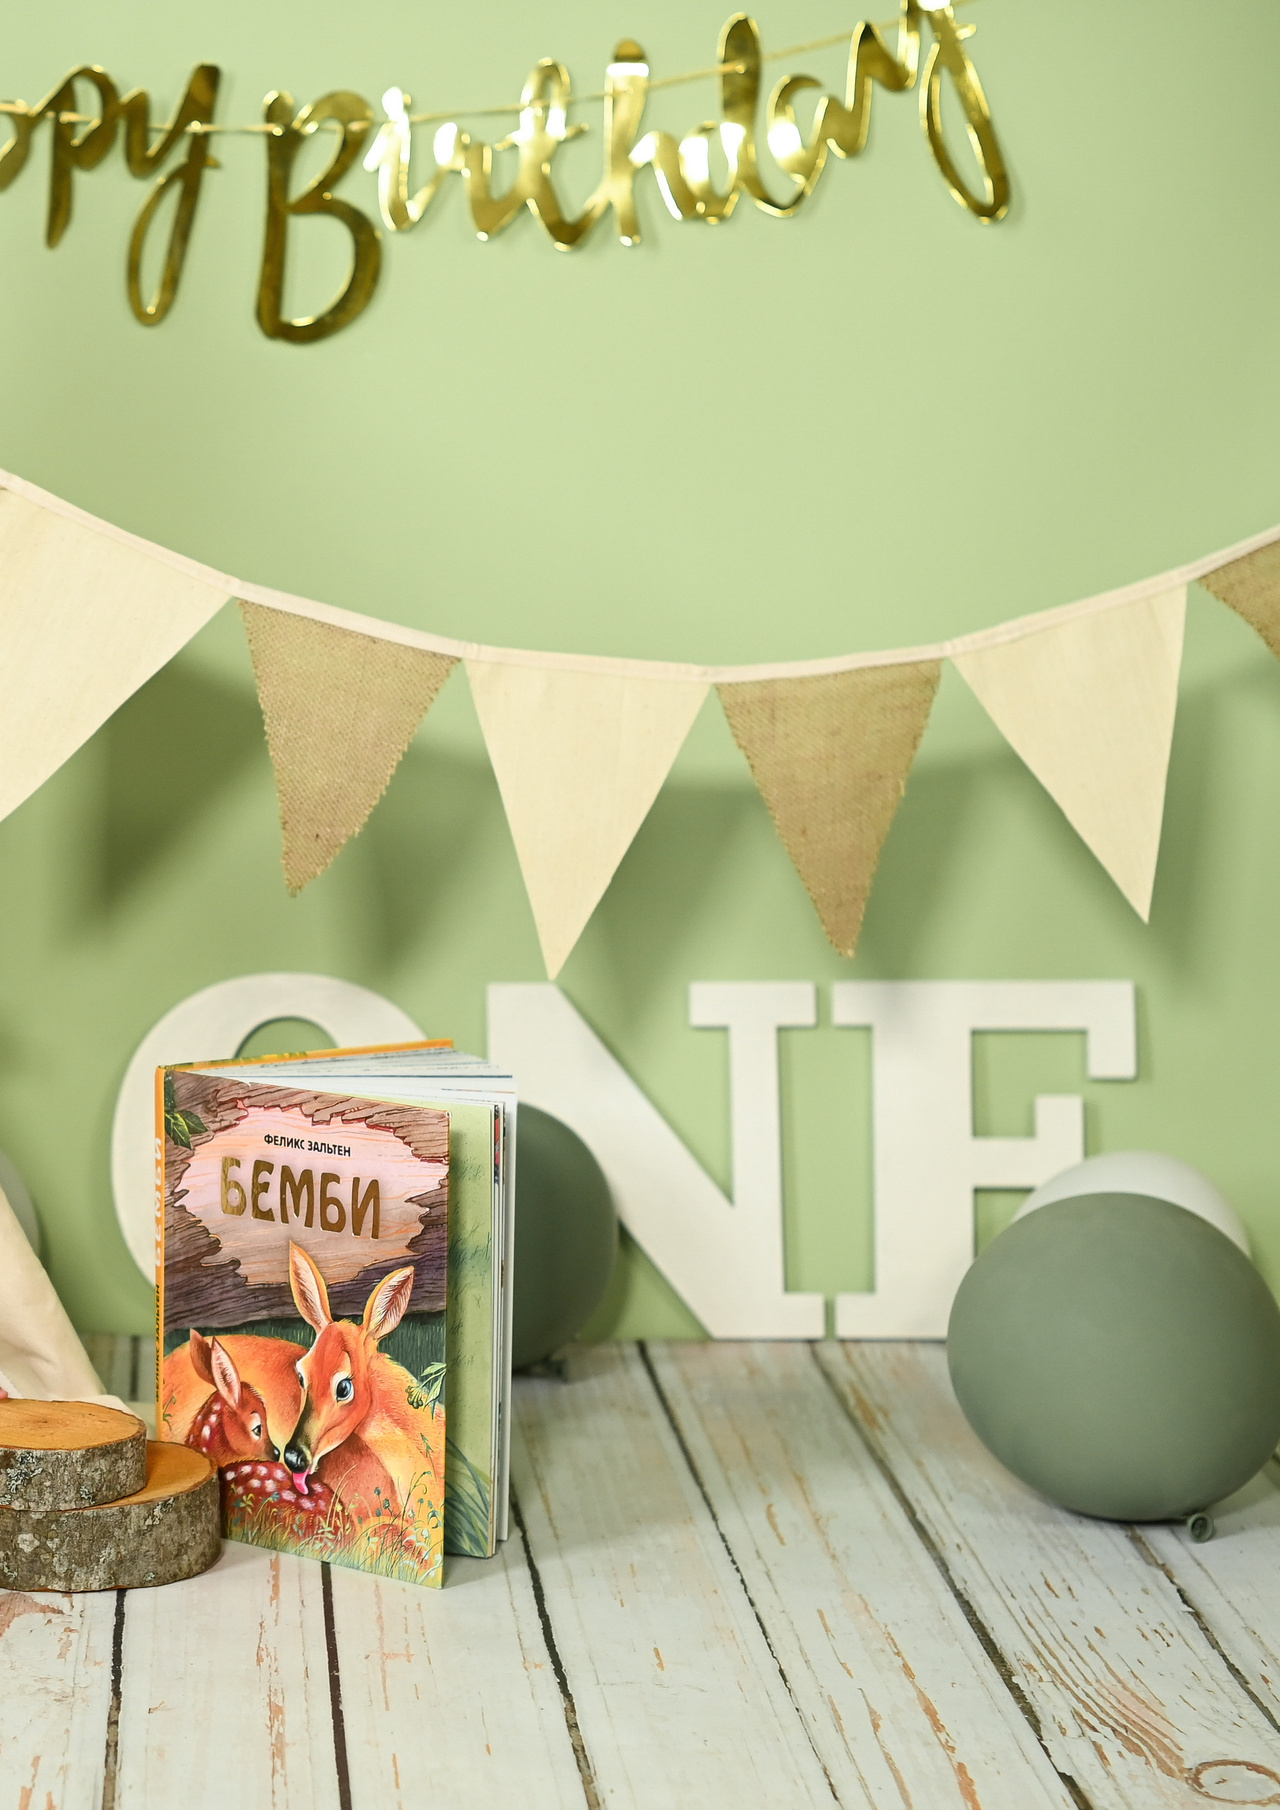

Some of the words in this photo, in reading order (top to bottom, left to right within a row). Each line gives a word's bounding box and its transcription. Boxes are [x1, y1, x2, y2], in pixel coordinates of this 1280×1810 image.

[256, 0, 1010, 345] Birthday
[263, 1133, 305, 1150] ФЕЛИКС
[307, 1140, 351, 1157] ЗАЛЬТЕН
[220, 1156, 381, 1241] БЕМБИ
